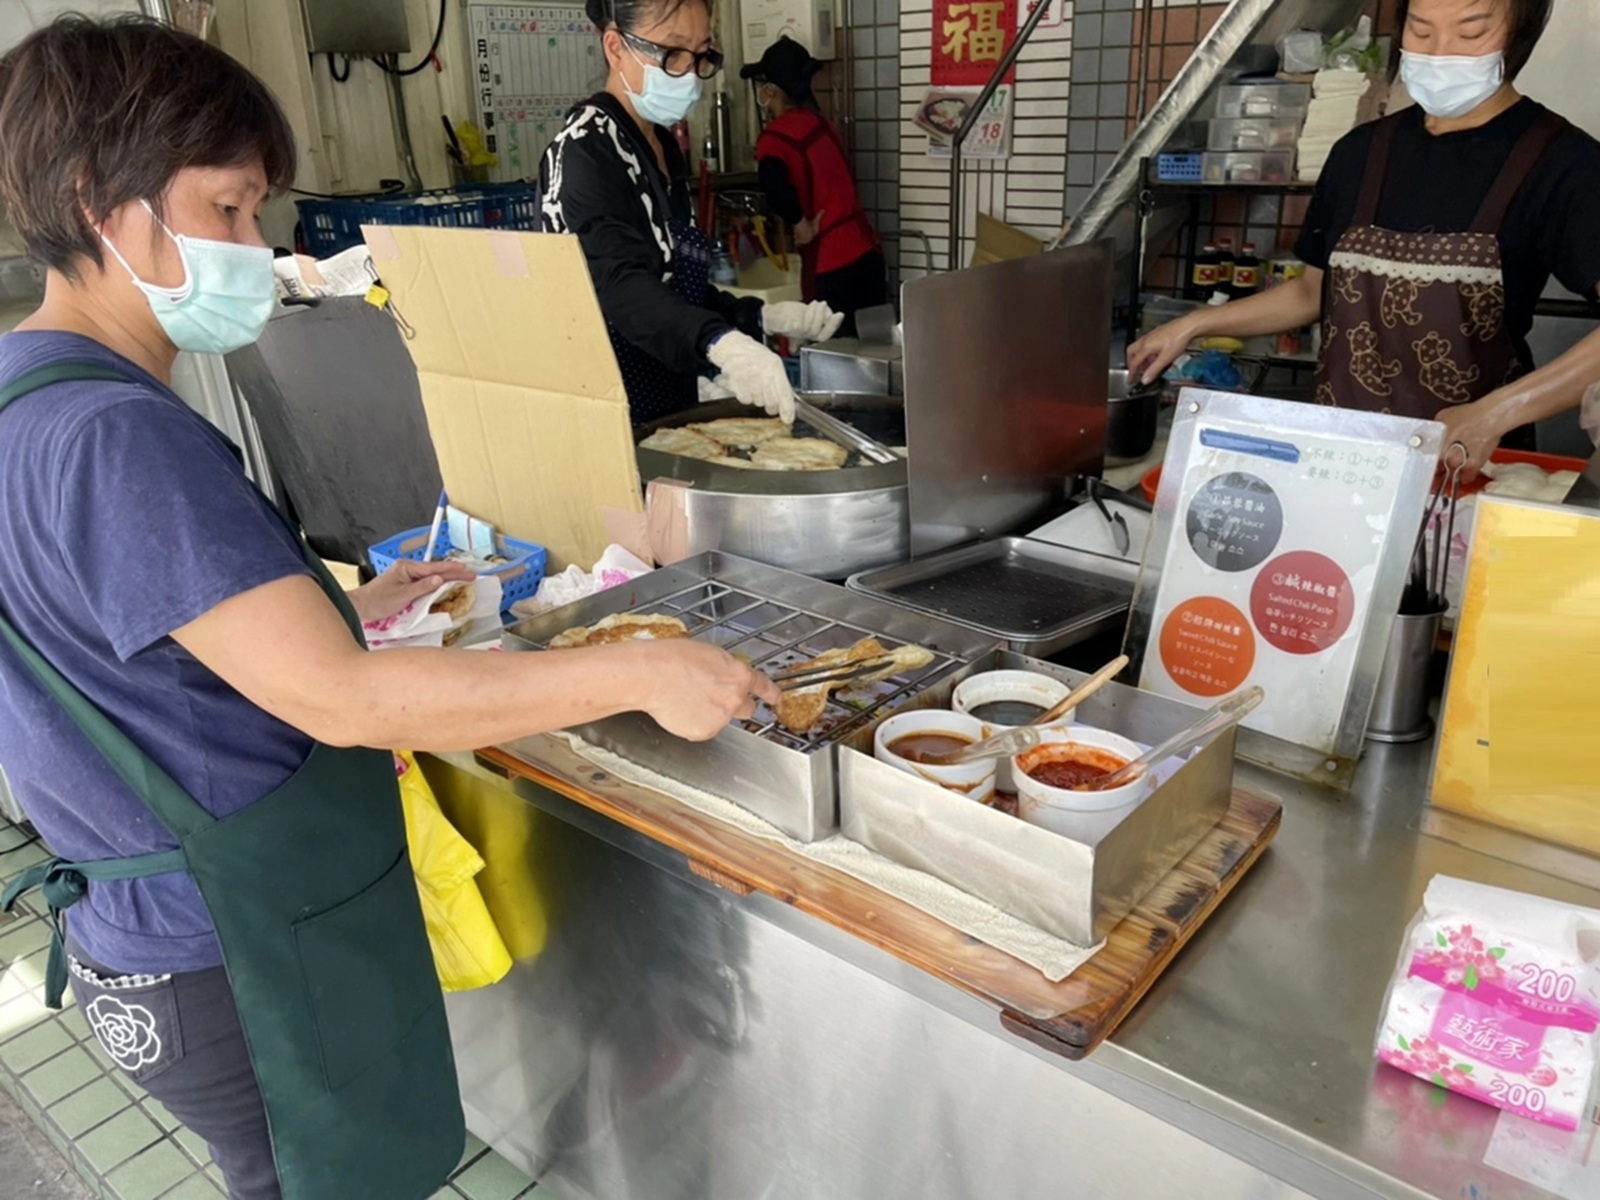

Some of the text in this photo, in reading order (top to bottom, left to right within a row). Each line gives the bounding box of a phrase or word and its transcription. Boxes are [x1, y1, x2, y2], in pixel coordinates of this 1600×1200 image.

[941, 1, 1006, 63] 福
[989, 90, 1007, 107] 17
[980, 122, 1001, 140] 18
[1268, 592, 1293, 606] Salted
[1310, 602, 1334, 615] Paste
[1517, 962, 1577, 1004] 200
[1441, 1012, 1530, 1062] 藝術家
[1488, 1078, 1547, 1113] 200
